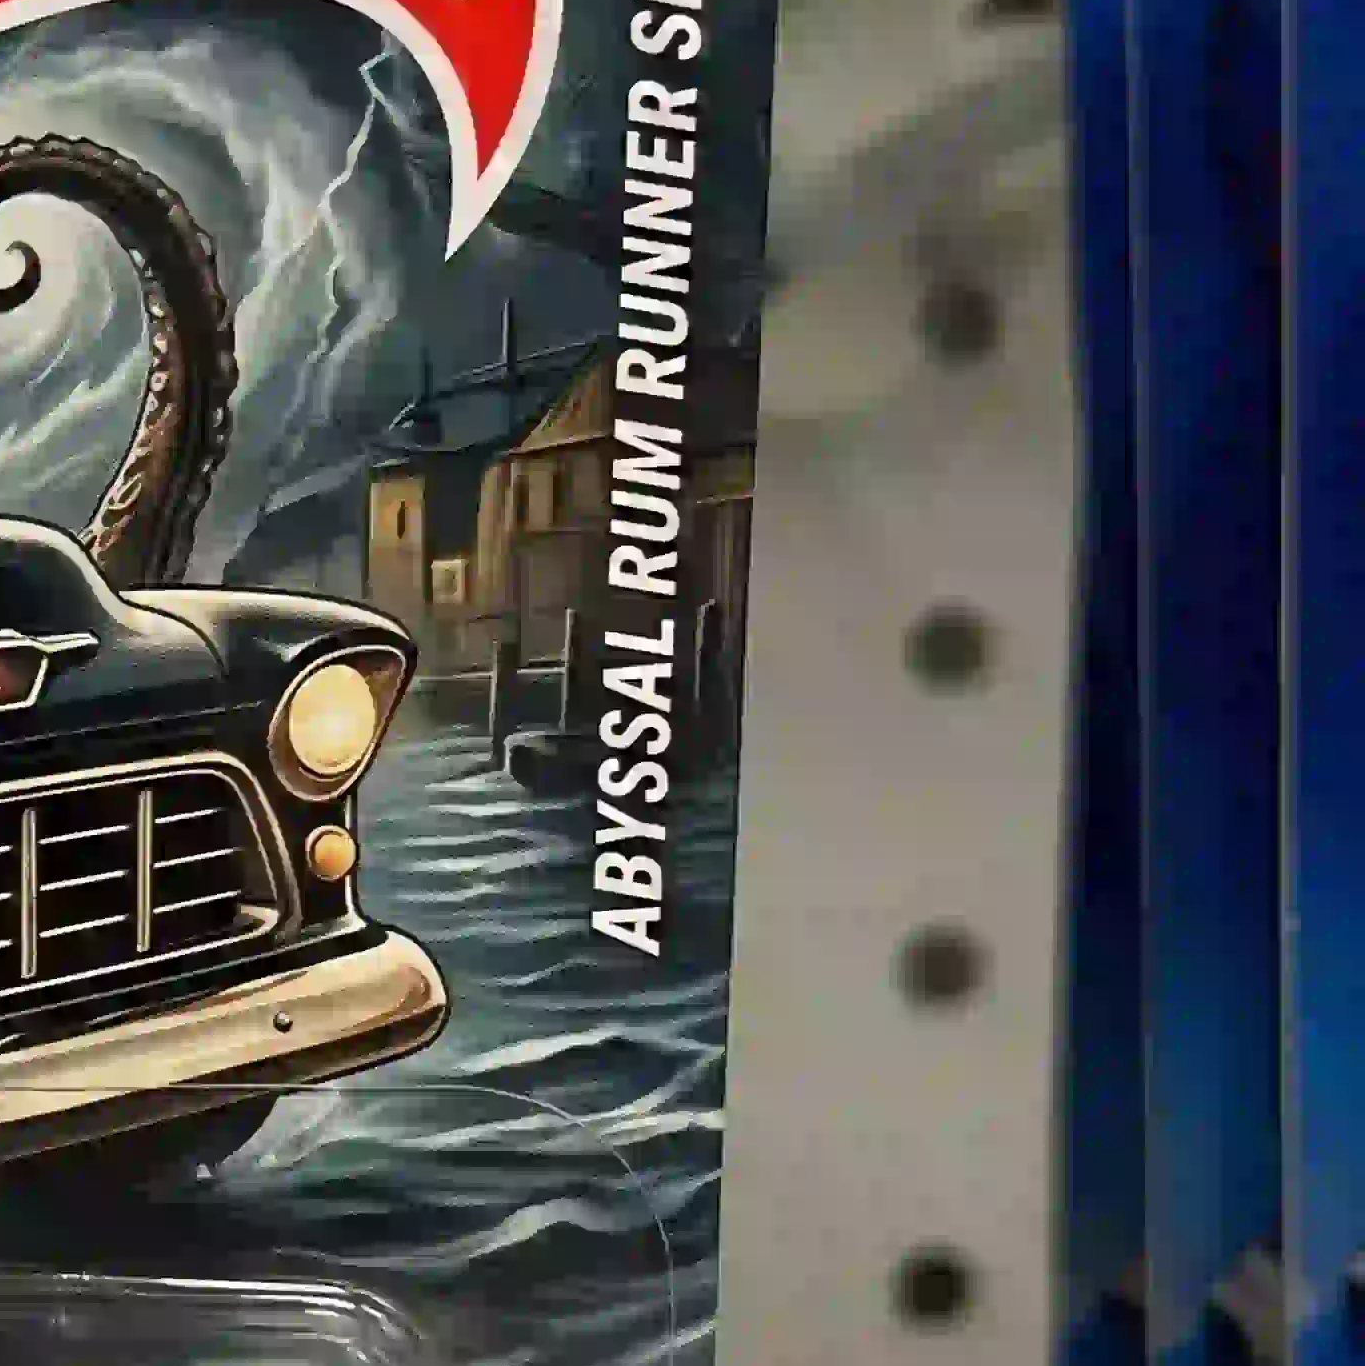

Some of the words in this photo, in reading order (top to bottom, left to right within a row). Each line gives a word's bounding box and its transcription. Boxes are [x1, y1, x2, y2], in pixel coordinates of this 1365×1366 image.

[616, 81, 697, 399] RUNNER
[609, 419, 682, 595] RUM
[593, 619, 674, 956] ABYSSAL
